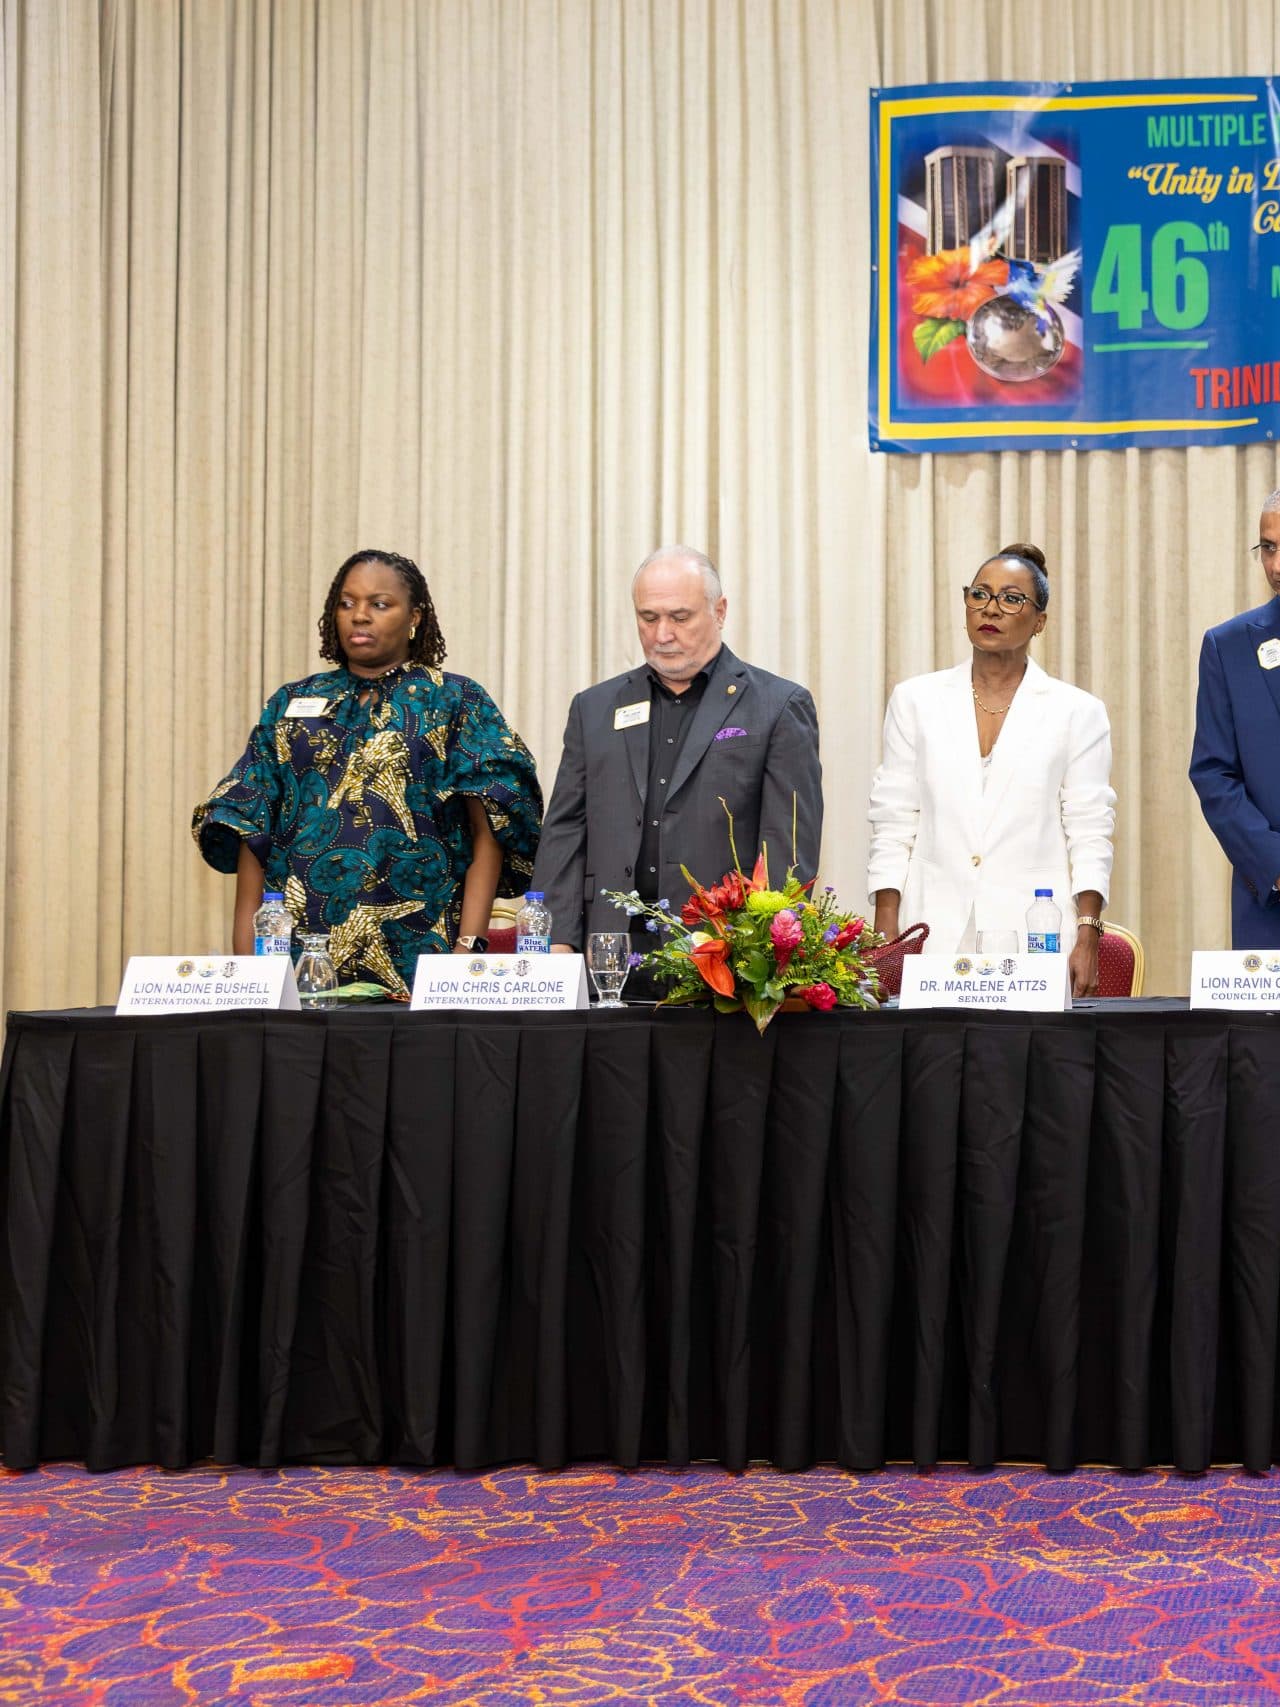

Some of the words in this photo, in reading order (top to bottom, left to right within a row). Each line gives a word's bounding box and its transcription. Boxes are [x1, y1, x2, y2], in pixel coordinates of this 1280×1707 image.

[1147, 113, 1267, 148] MULTIPLE
[1128, 163, 1223, 204] “Unity
[1227, 166, 1254, 194] in
[1091, 220, 1230, 330] 46th
[133, 982, 162, 994] LION
[165, 982, 212, 994] NADINE
[214, 982, 270, 994] BUSHELL
[429, 981, 459, 993] LION
[462, 981, 500, 993] CHRIS
[504, 981, 564, 993] CARLONE
[920, 980, 940, 992] DR.
[944, 980, 1004, 992] MARLENE
[1008, 980, 1047, 991] ATTZS
[1201, 977, 1230, 989] LION
[1234, 977, 1272, 989] RAVIN
[130, 997, 213, 1006] INTERNATIONAL
[214, 997, 269, 1005] DIRECTOR
[424, 996, 508, 1005] INTERNATIONAL
[511, 996, 565, 1005] DIRECTOR
[958, 995, 1008, 1003] SENATOR
[1211, 992, 1258, 1001] COUNCIL
